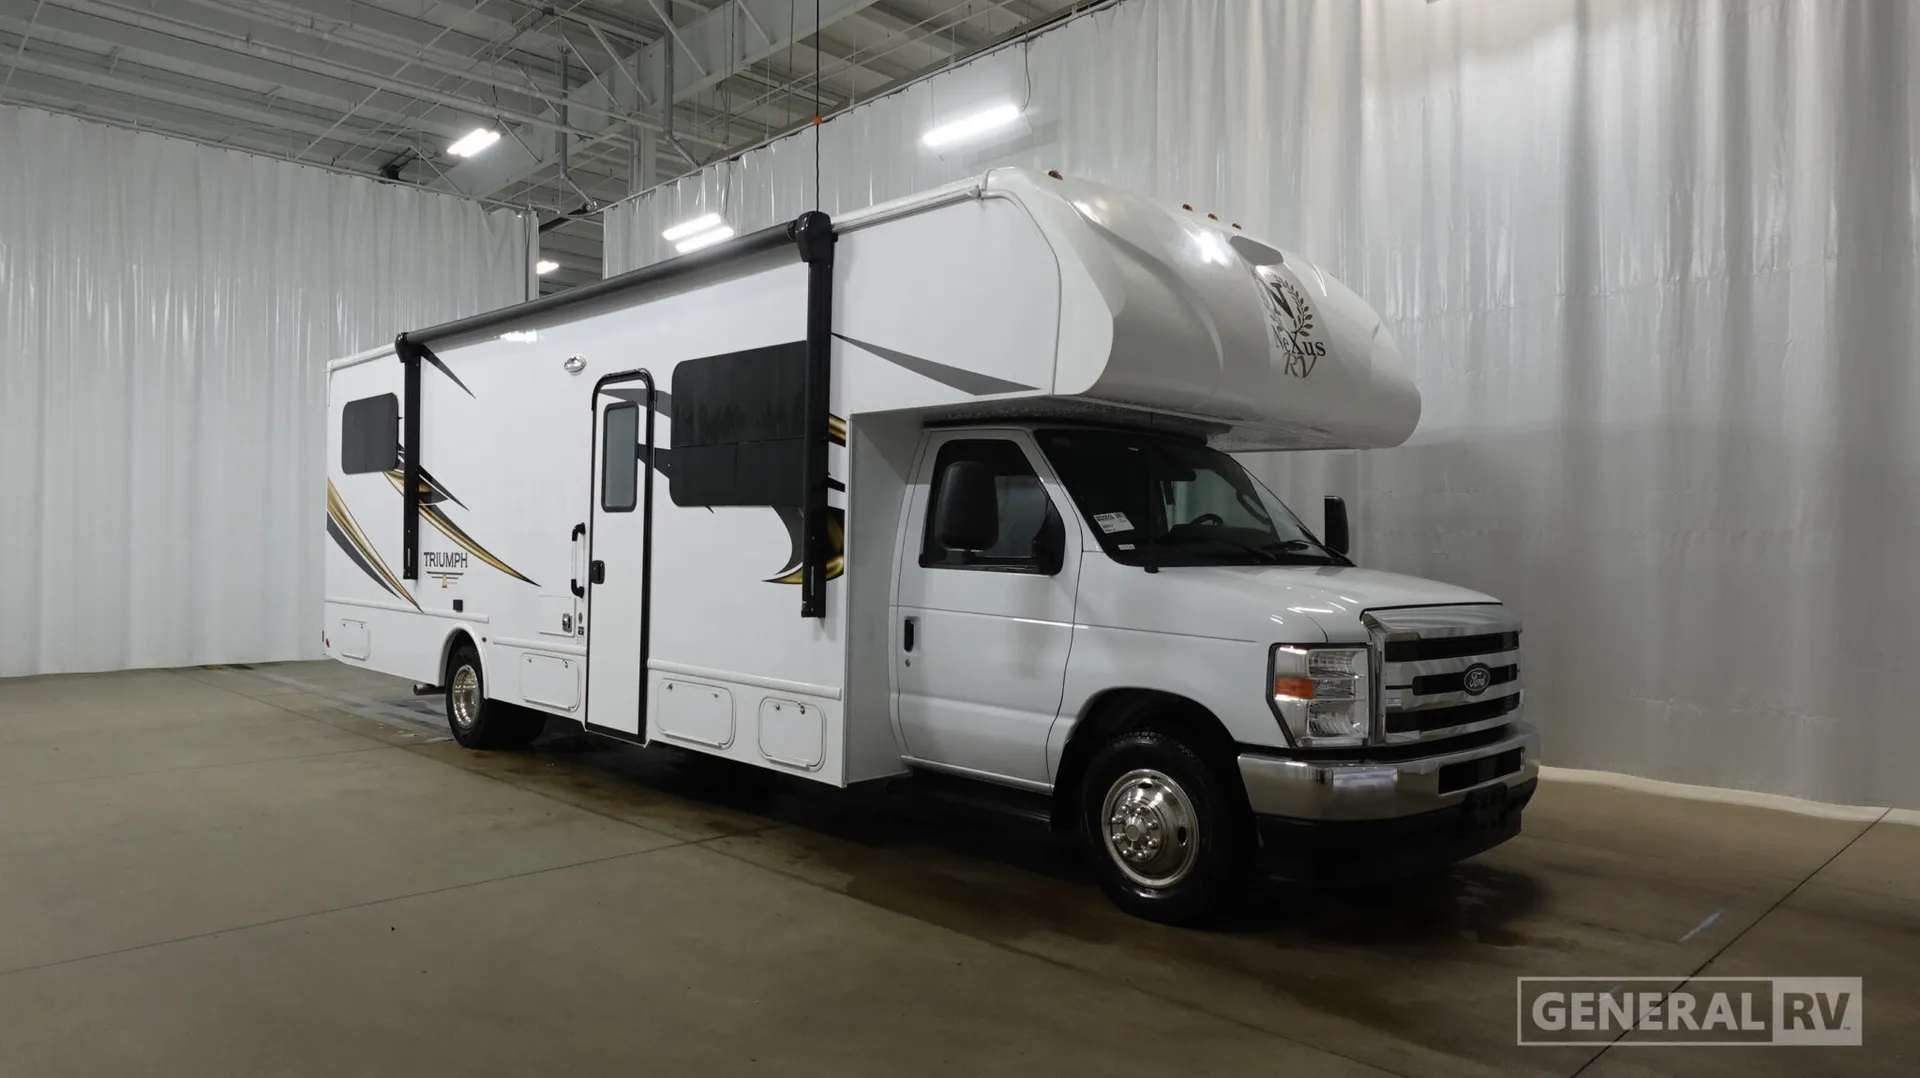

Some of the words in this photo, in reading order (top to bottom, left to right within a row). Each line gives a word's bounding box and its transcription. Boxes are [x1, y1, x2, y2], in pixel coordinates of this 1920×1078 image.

[1282, 351, 1318, 379] RV
[423, 552, 468, 568] TRIUMPH
[1469, 672, 1486, 688] Ford
